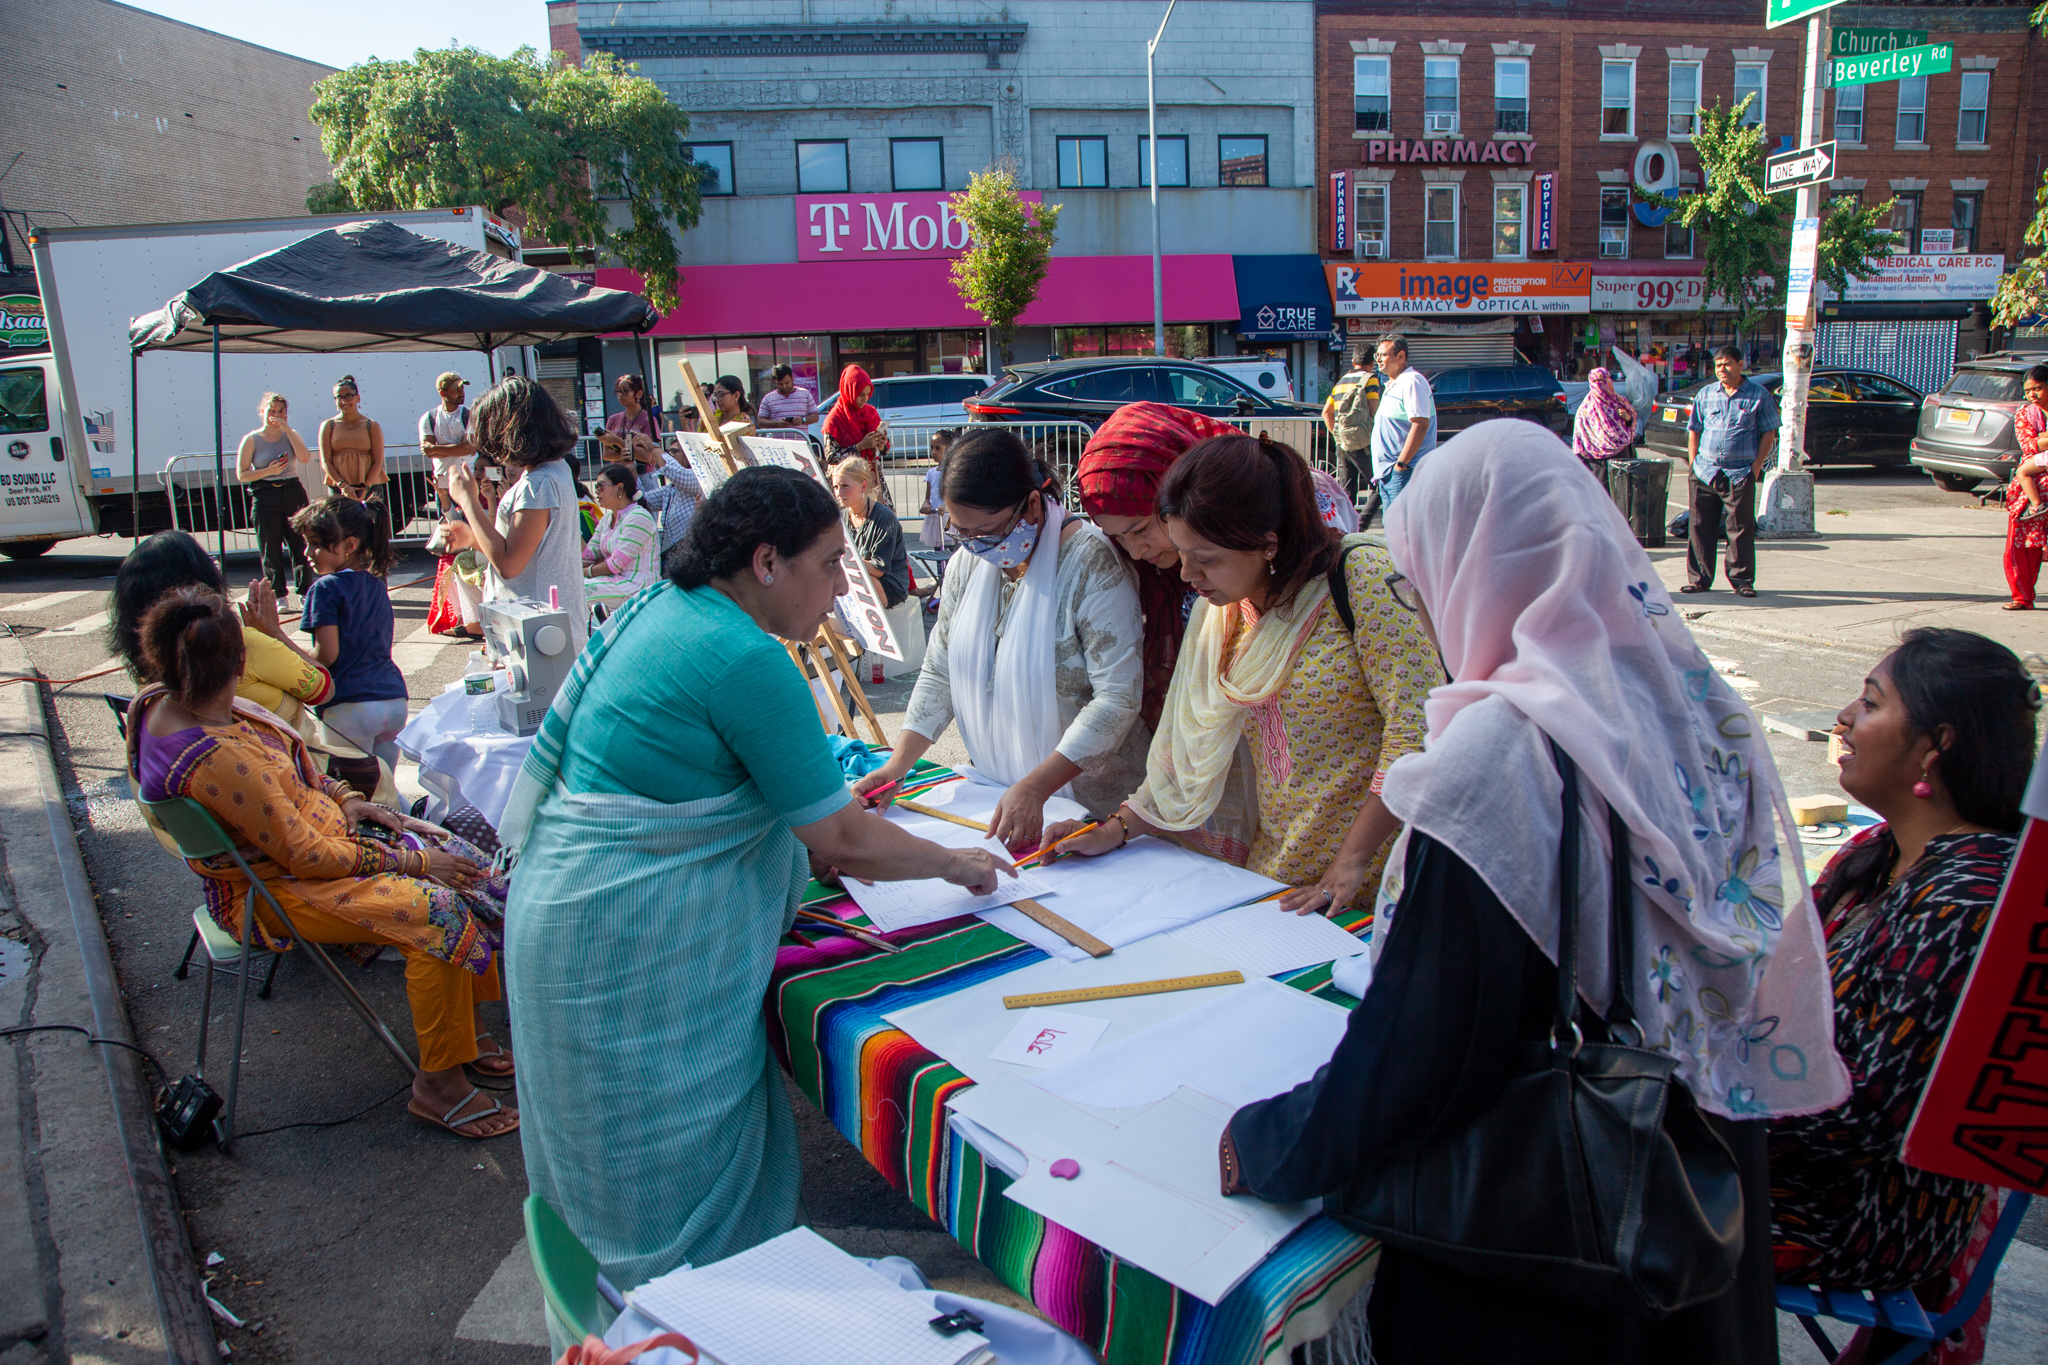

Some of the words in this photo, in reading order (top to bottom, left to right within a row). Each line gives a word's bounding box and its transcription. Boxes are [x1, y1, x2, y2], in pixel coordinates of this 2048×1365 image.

[1838, 30, 1898, 53] Church
[1905, 33, 1918, 46] Av
[1835, 52, 1923, 82] Beverley
[1931, 45, 1947, 60] Rd
[1368, 140, 1538, 163] PHARMACY
[1775, 163, 1794, 180] ONE
[1802, 156, 1824, 174] WAY
[1330, 171, 1346, 180] image
[1535, 172, 1553, 181] image
[1336, 180, 1346, 250] PHARMACY
[1541, 181, 1552, 250] OPTICAL
[859, 200, 976, 252] Mob
[1876, 257, 1933, 268] MEDICAL
[1938, 257, 1971, 268] CARE
[1974, 257, 1997, 268] P.C.
[1399, 266, 1489, 304] image
[1493, 277, 1547, 286] PRESCRIPTION
[1904, 273, 1932, 285] Azmir,
[1933, 273, 1947, 283] MD
[1493, 285, 1522, 293] CENTER
[1596, 279, 1637, 294] Super
[1371, 300, 1454, 312] PHARMACY
[1477, 299, 1539, 311] OPTICAL
[1541, 301, 1570, 311] within
[1674, 296, 1690, 305] plus
[1343, 303, 1356, 311] 119
[1276, 307, 1316, 320] TRUE
[1276, 319, 1316, 331] CARE
[1377, 318, 1393, 326] CVS
[0, 474, 12, 486] BD
[12, 473, 41, 486] SOUND
[40, 471, 57, 484] LLC
[8, 487, 24, 495] Deer
[24, 486, 42, 495] Park,
[42, 485, 52, 493] NY
[5, 497, 16, 507] US
[16, 495, 31, 506] DOT
[31, 493, 61, 505] 3346219
